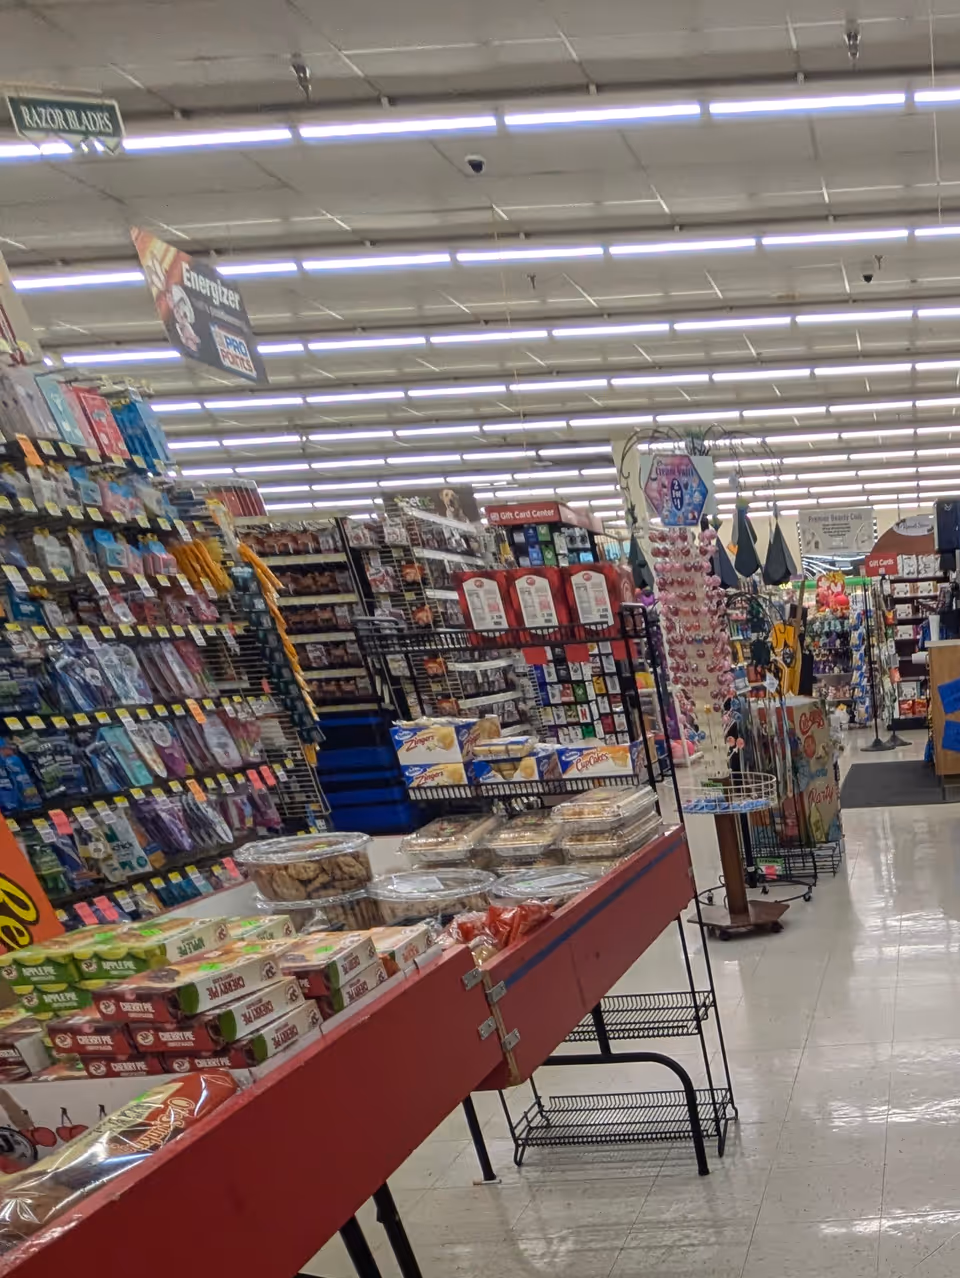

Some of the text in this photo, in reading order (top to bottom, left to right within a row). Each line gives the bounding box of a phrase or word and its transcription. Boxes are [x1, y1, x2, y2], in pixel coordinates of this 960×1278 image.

[20, 106, 113, 132] RAZOR BLADES
[182, 260, 241, 311] Energizer
[225, 335, 249, 358] PRO
[220, 348, 253, 373] POINTS
[500, 508, 555, 520] Gift Card Center
[879, 559, 894, 567] Cards
[406, 734, 435, 752] Zingers
[575, 753, 609, 773] CupCakes
[22, 966, 56, 977] APPLE PIE
[102, 960, 137, 971] APPLE PIE
[206, 978, 246, 1000] CHERRY PIE
[43, 993, 79, 1003] APPLE PIE
[120, 1001, 155, 1013] CHERRY PIE
[254, 1001, 274, 1020] CHERRY
[76, 1035, 115, 1045] CHERRY PIE
[158, 1031, 196, 1042] CHERRY PIE
[110, 1062, 149, 1072] CHERRY PIE
[195, 1056, 232, 1068] CHERRY PIE
